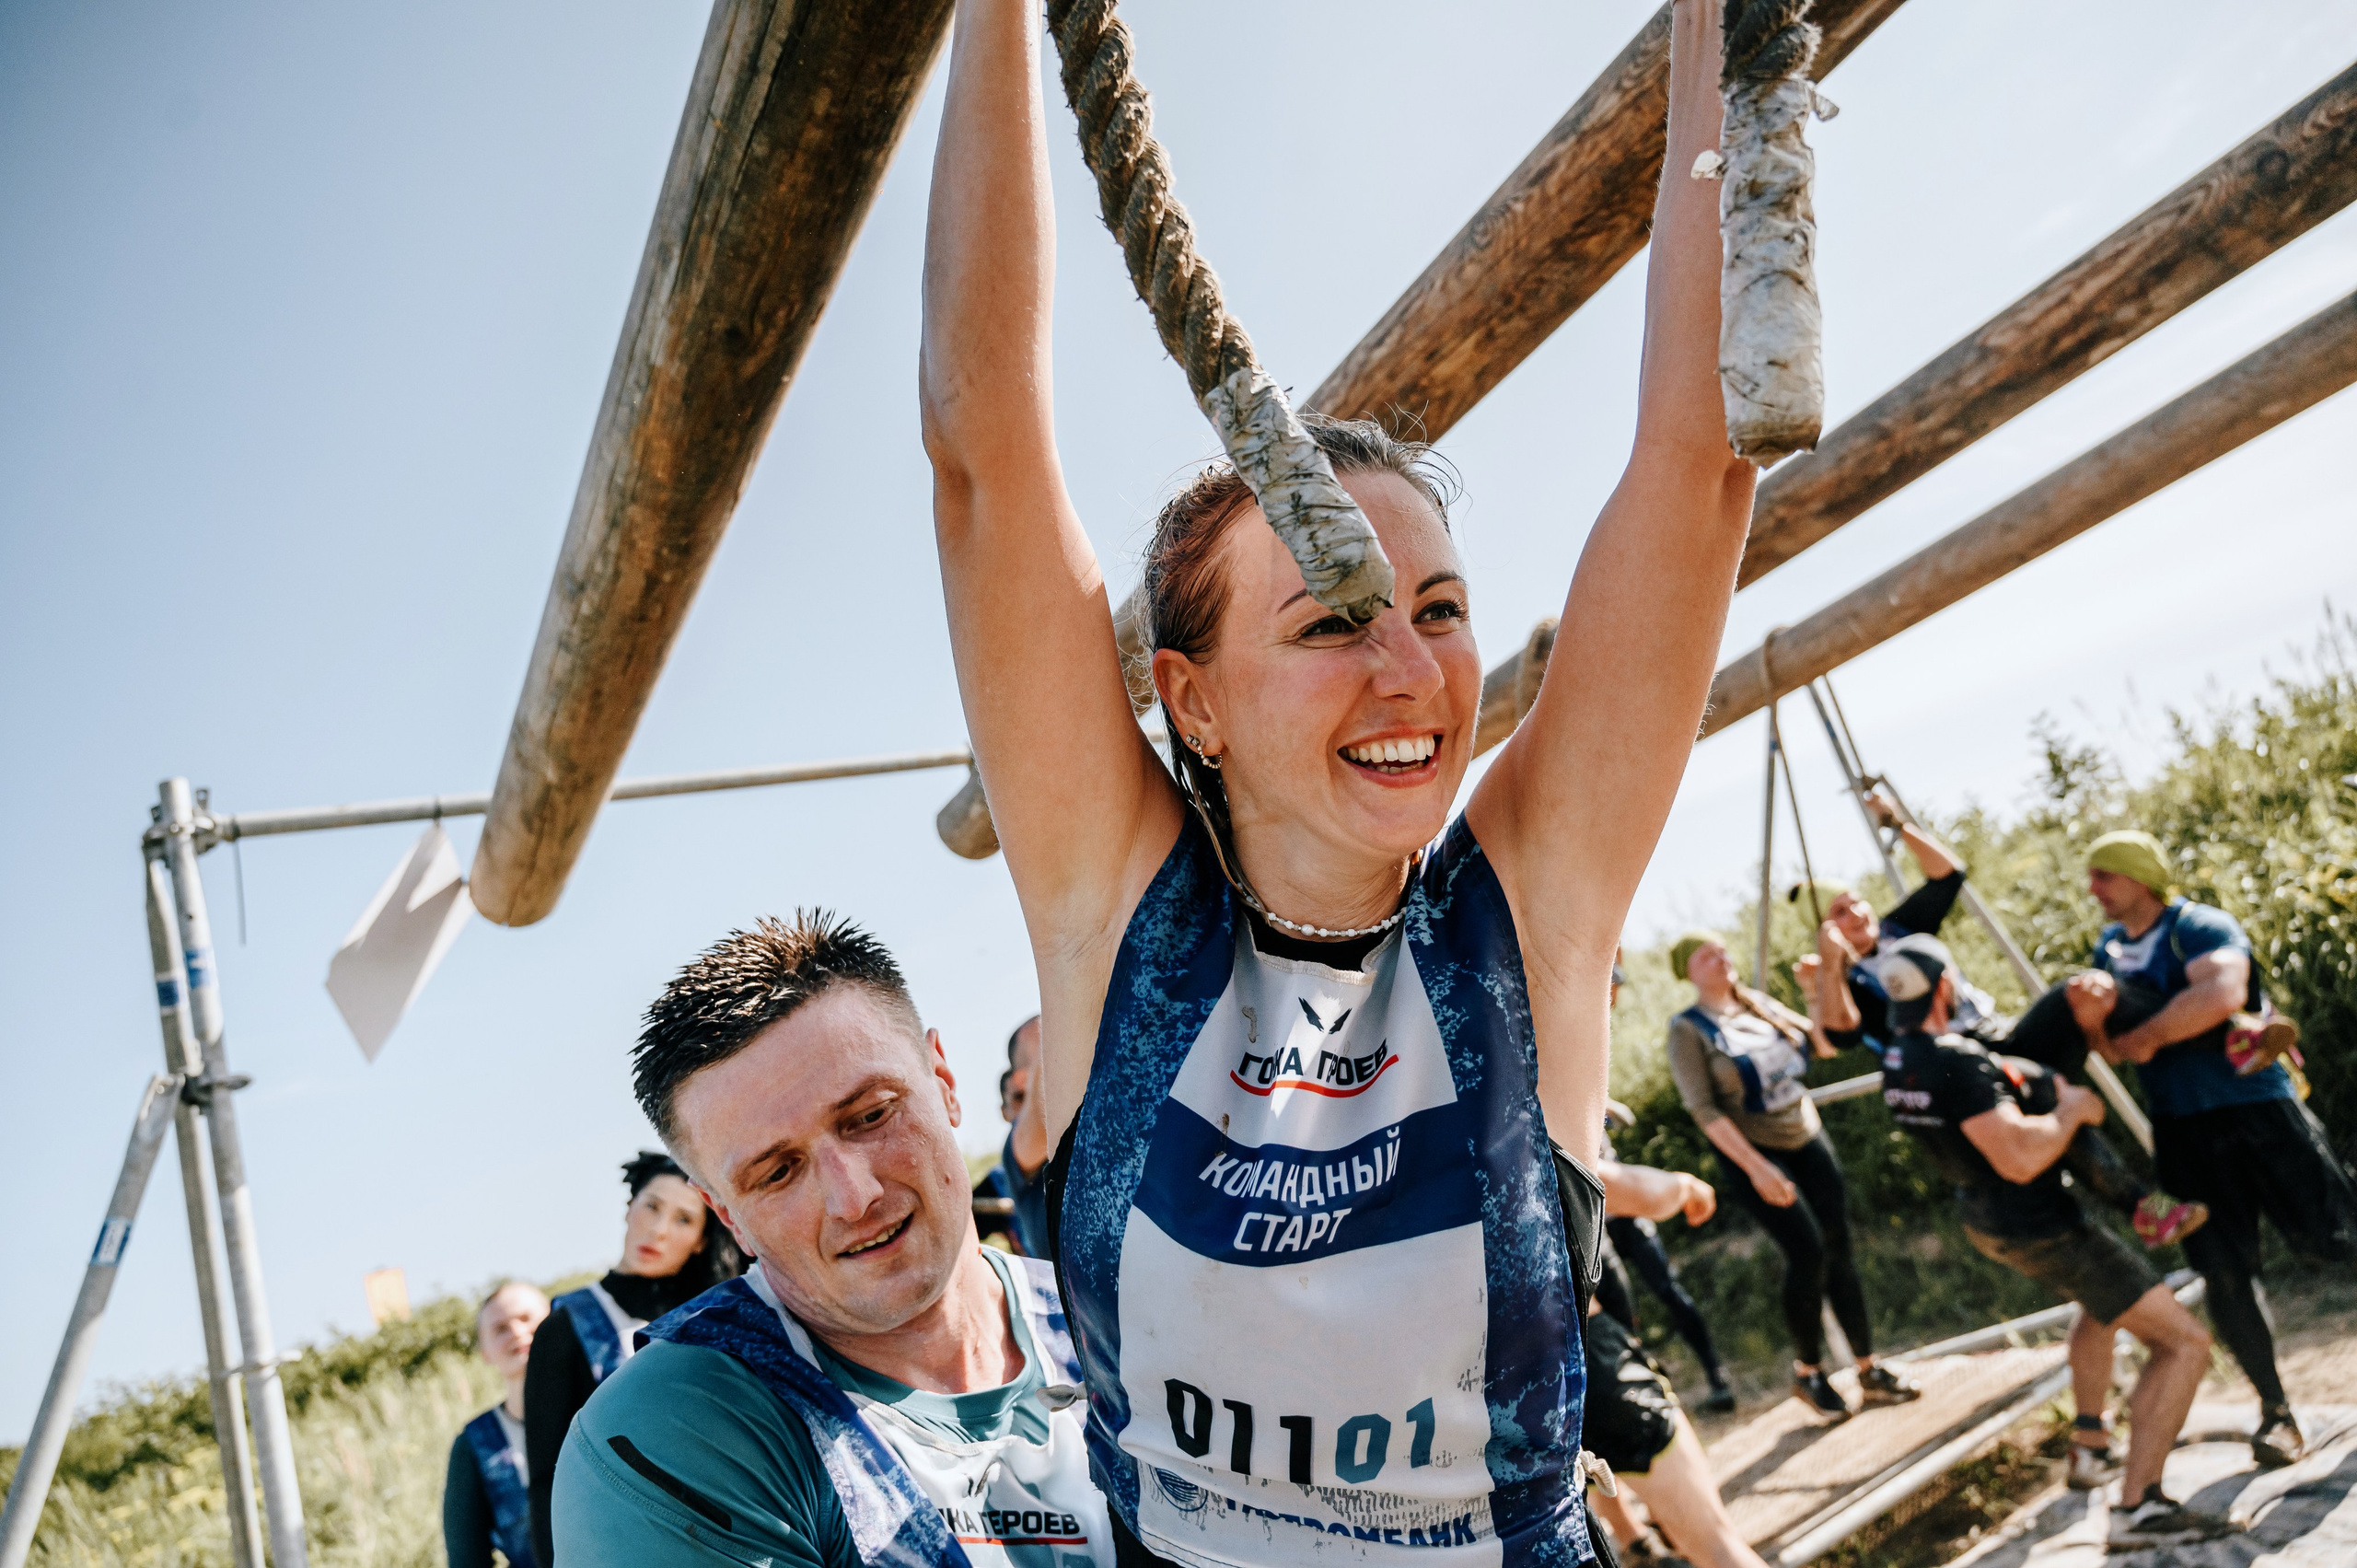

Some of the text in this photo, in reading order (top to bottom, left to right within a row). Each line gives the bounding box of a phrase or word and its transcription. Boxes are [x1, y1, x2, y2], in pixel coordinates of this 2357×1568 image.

[1238, 1038, 1387, 1086] ГОКА ГРОЕВ
[1198, 1125, 1400, 1208] КОМАНДНЫЙ
[1233, 1207, 1352, 1252] СТАРТ
[1165, 1378, 1435, 1485] 01101
[977, 1510, 1080, 1535] ГЕРОЕВ
